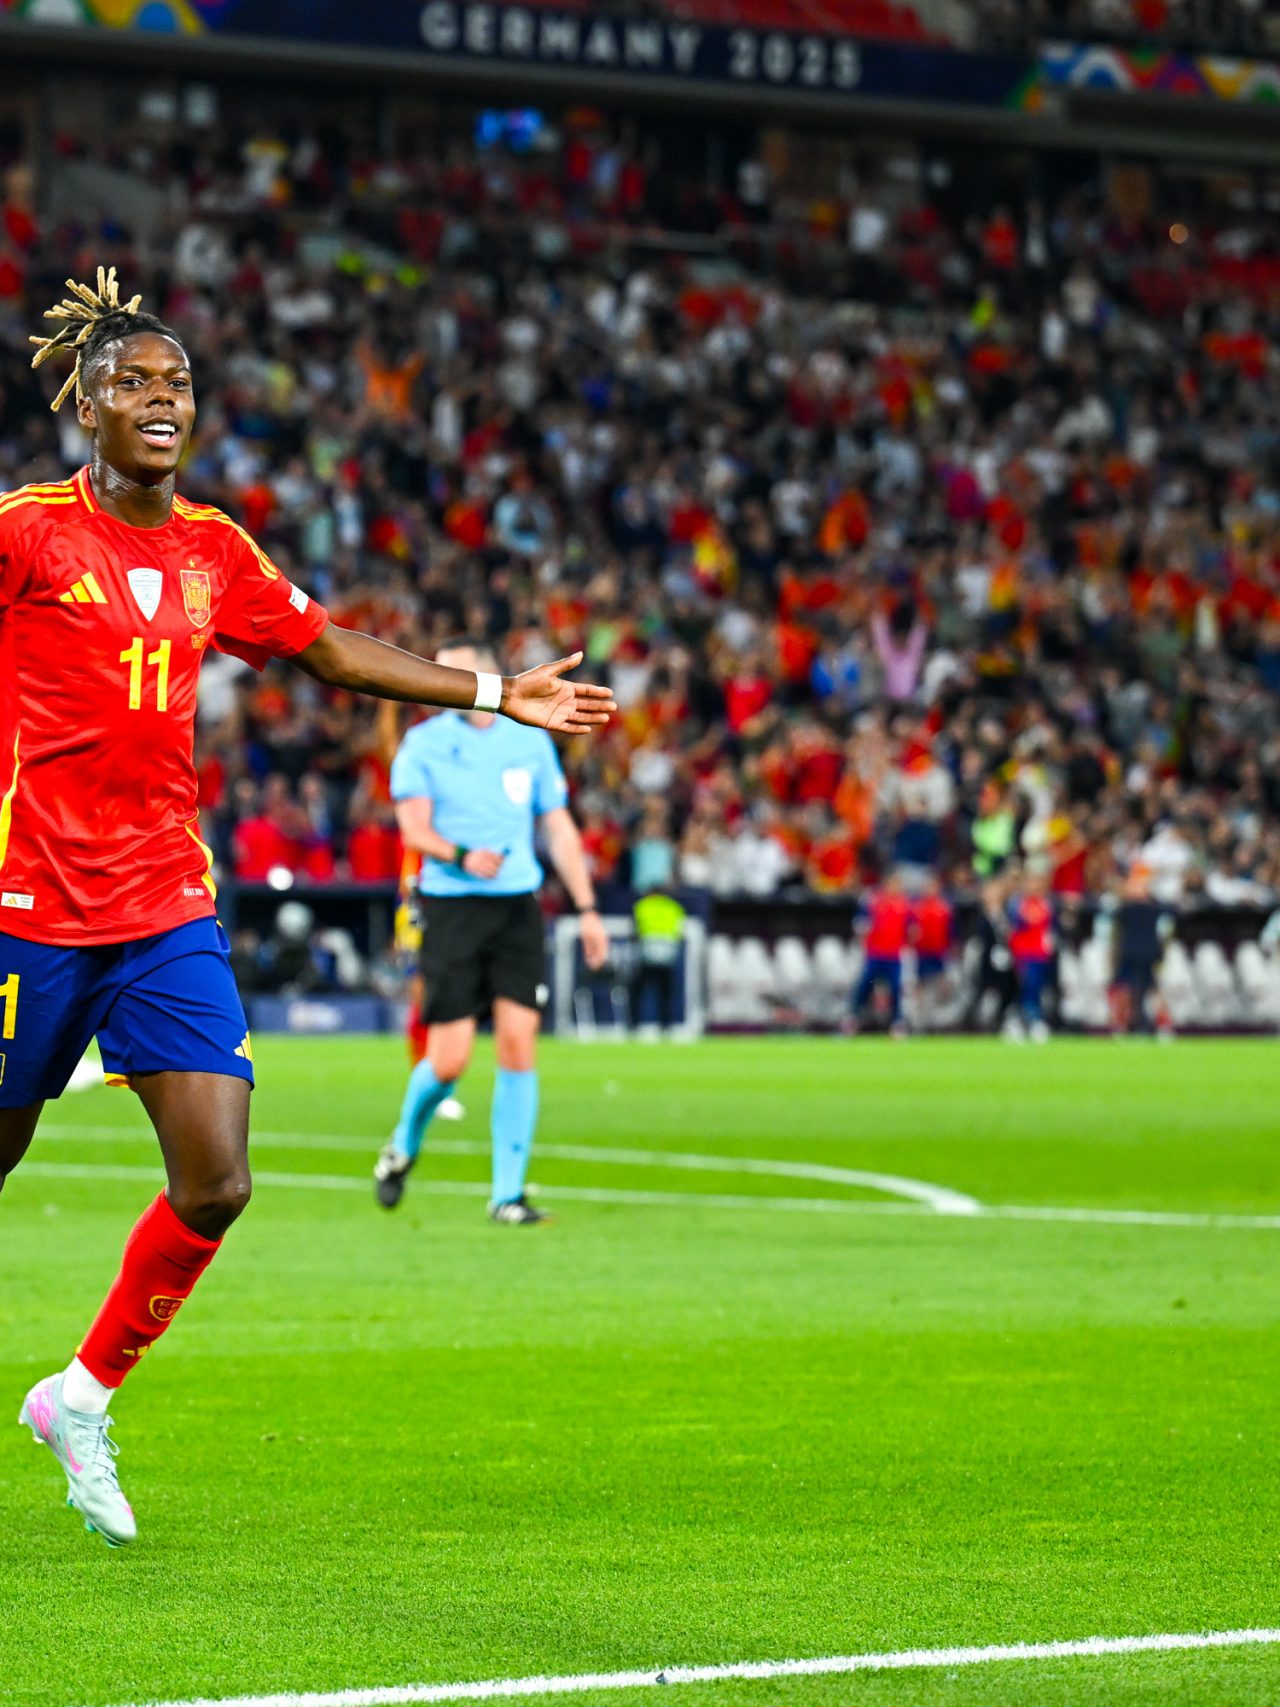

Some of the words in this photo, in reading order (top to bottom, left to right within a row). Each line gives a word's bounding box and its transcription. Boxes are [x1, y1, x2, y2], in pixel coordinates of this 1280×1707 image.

[420, 3, 701, 73] GERMANY
[727, 29, 861, 88] 2025
[120, 637, 171, 712] 11
